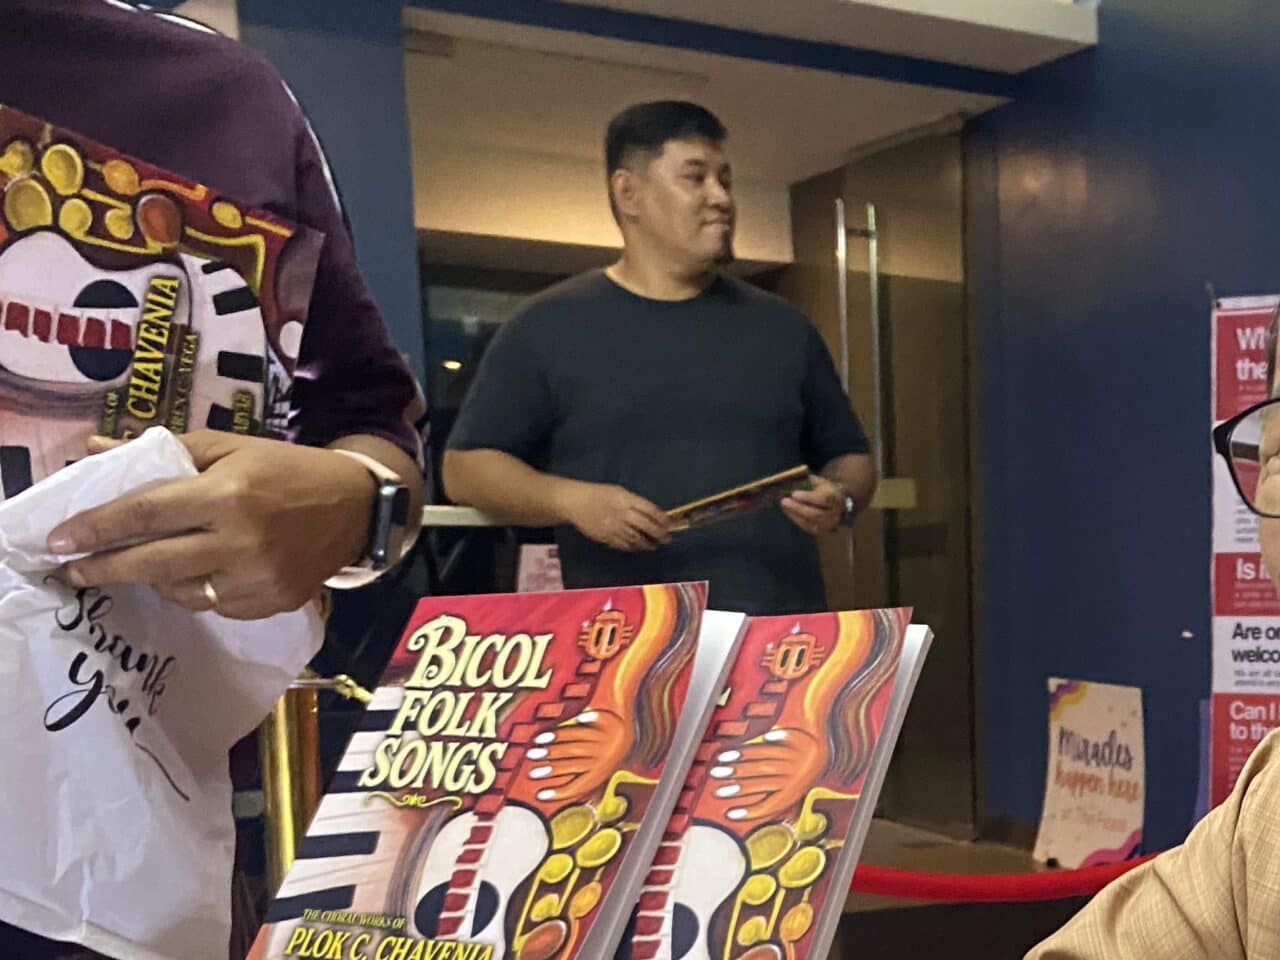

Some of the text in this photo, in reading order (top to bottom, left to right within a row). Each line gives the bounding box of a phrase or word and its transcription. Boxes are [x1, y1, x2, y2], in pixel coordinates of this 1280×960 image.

[127, 277, 180, 420] CHAVENIA
[1236, 557, 1256, 580] Is
[1232, 621, 1262, 640] Are
[404, 614, 554, 690] BICOL
[386, 690, 514, 739] FOLK
[1229, 700, 1267, 720] Can
[1269, 702, 1276, 720] I
[1229, 722, 1269, 740] to th
[358, 737, 510, 793] SONGS
[284, 927, 350, 960] PLOK
